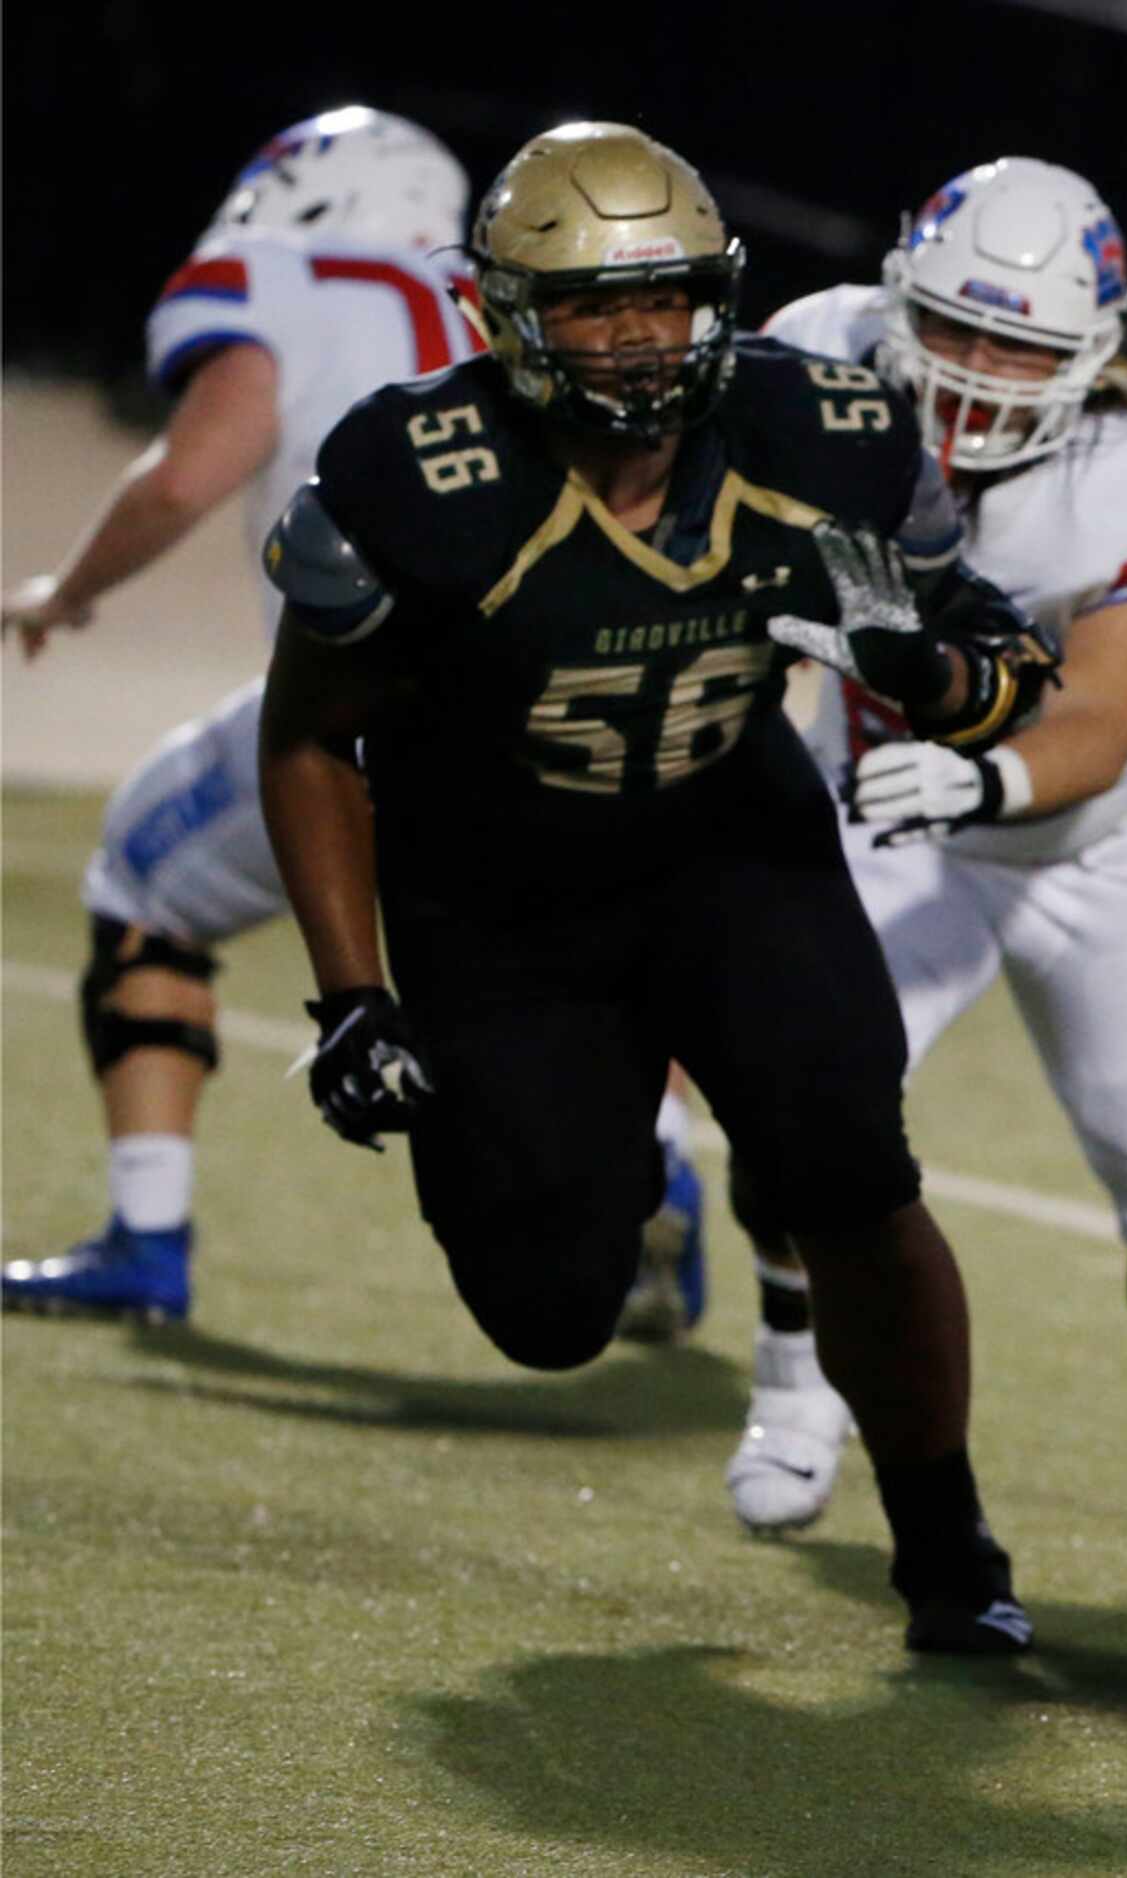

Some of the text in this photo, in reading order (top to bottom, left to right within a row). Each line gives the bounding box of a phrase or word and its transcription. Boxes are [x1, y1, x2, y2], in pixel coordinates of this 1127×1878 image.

[803, 362, 891, 431] 56
[406, 403, 500, 494] 56
[595, 609, 748, 654] BIRDVILLE
[524, 641, 774, 796] 56
